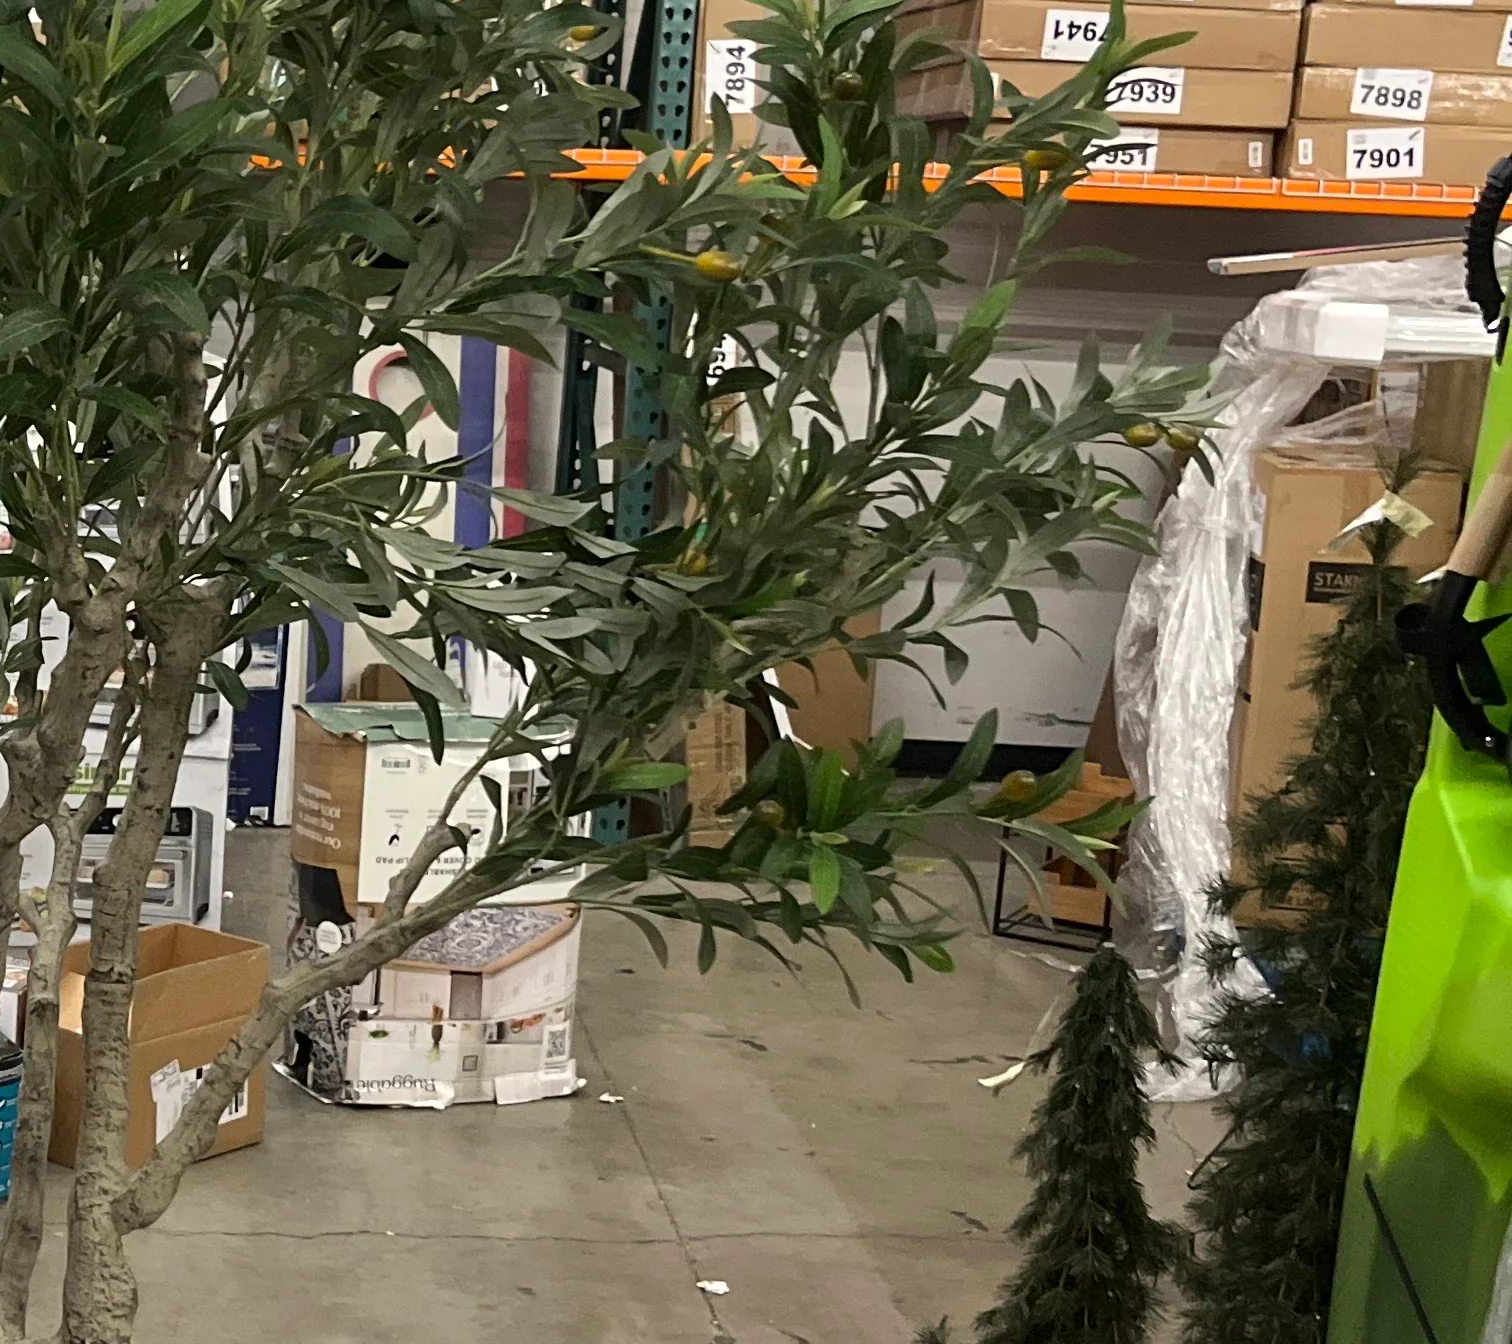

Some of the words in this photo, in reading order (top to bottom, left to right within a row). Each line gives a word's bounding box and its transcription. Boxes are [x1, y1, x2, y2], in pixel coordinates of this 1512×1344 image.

[725, 44, 747, 105] 7894
[1115, 82, 1177, 104] 7939
[1360, 83, 1423, 111] 7898
[1353, 147, 1416, 169] 7901
[355, 1074, 436, 1094] Ruggable
